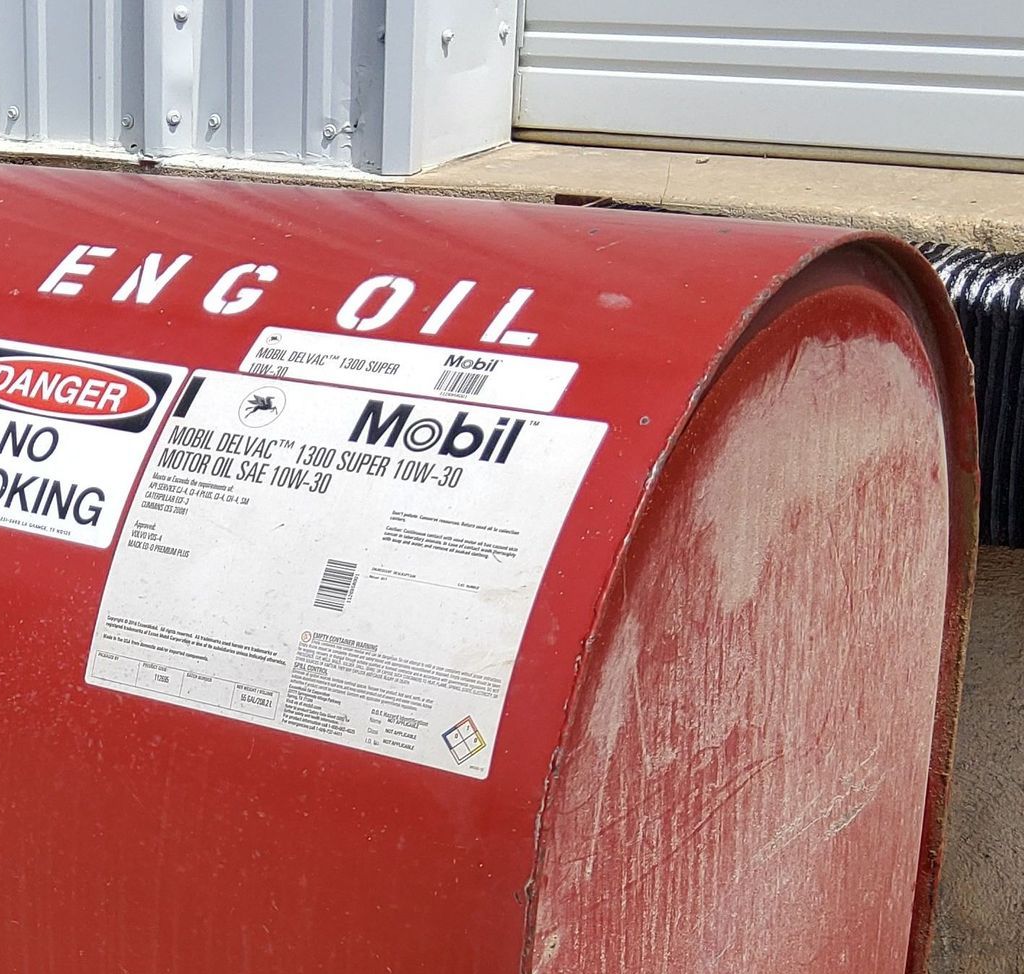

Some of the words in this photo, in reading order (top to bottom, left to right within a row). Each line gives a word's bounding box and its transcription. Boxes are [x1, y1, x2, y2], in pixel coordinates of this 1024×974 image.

[38, 244, 279, 315] ENG
[335, 274, 539, 346] OIL
[255, 346, 287, 363] MOBIL
[339, 357, 366, 372] 1300
[367, 360, 401, 376] SUPER
[443, 354, 499, 373] Mobil
[348, 399, 526, 464] Mobil
[157, 447, 212, 475] MOTOR
[211, 456, 234, 479] OIL
[235, 460, 270, 484] SAE
[270, 465, 333, 494] 10W-30
[168, 425, 214, 450] MOBIL
[295, 444, 337, 469] 1300
[336, 450, 391, 477] SUPER
[393, 458, 464, 488] 10W-30
[157, 483, 177, 492] SERVICE
[176, 548, 190, 558] PLUS
